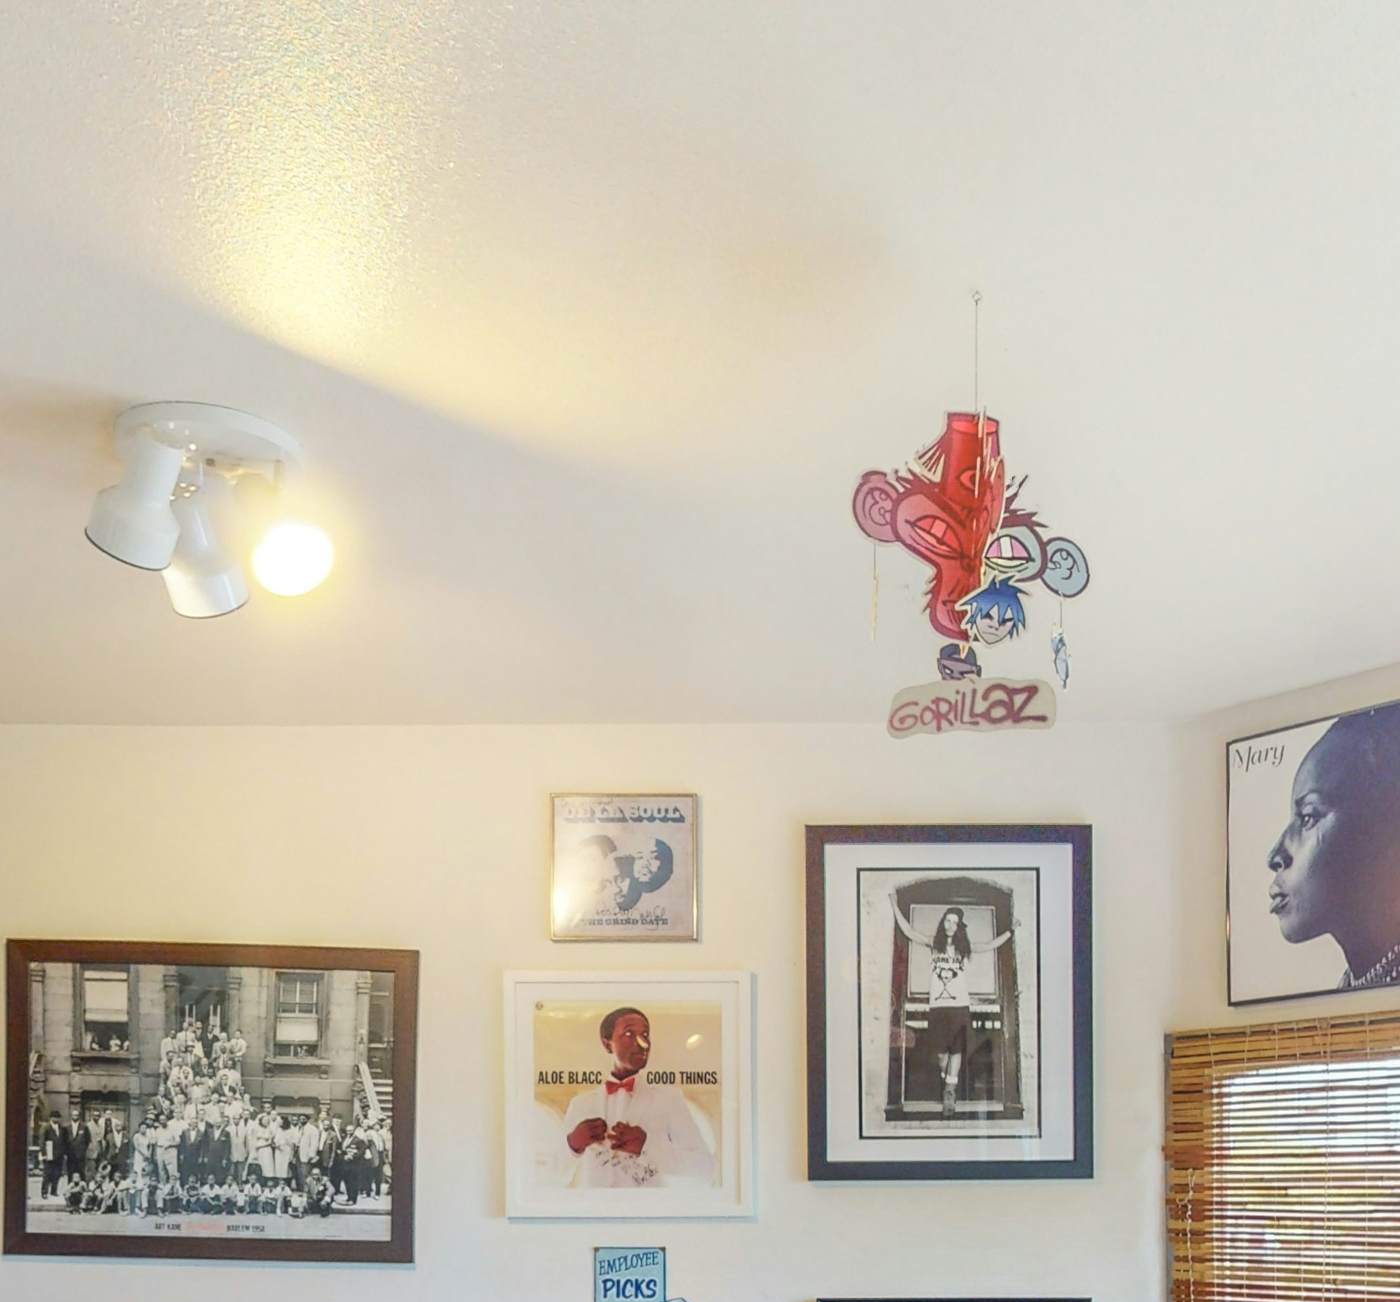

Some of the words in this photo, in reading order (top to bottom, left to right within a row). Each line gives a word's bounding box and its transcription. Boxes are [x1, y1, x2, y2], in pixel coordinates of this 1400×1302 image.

[1232, 744, 1286, 773] Mary
[629, 804, 686, 823] SOUL
[537, 1071, 565, 1085] ALOE
[646, 1071, 677, 1085] GOOD
[679, 1071, 718, 1085] THINGS
[597, 1250, 660, 1276] EMPLOYEE
[601, 1278, 658, 1299] PICKS
